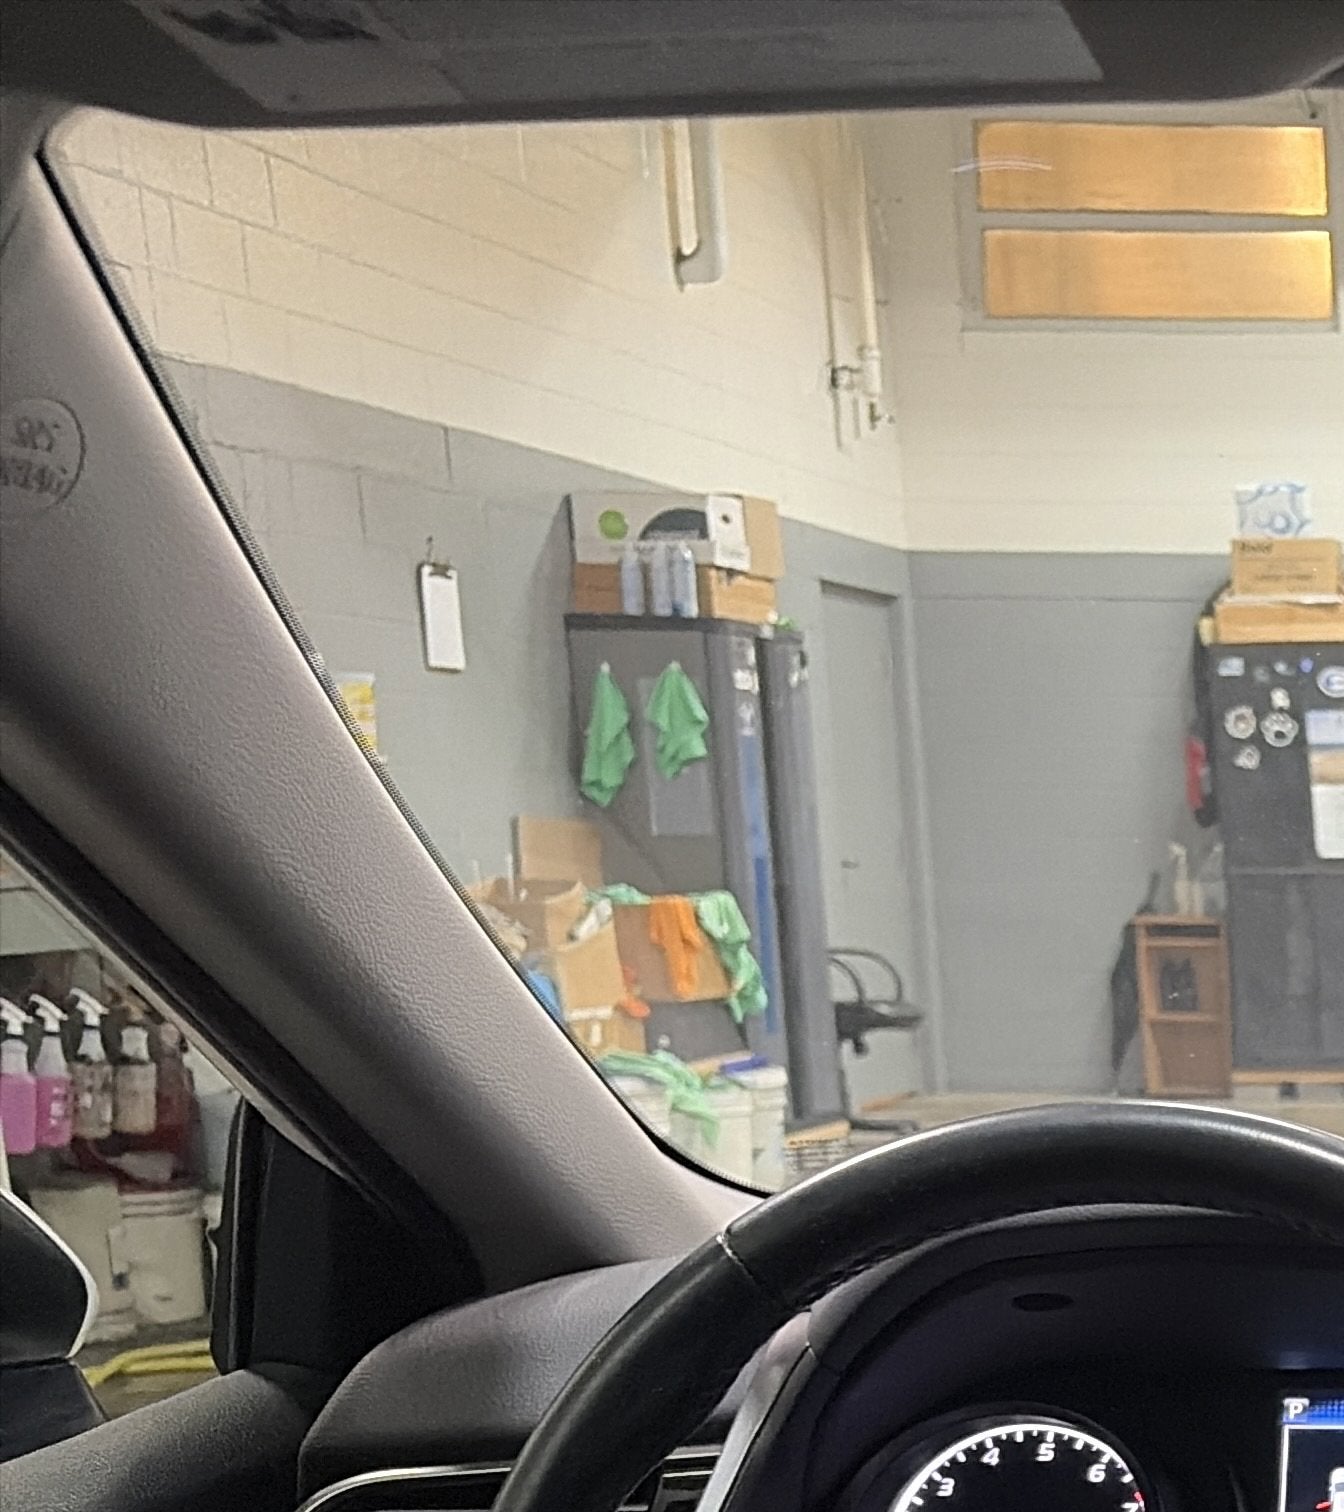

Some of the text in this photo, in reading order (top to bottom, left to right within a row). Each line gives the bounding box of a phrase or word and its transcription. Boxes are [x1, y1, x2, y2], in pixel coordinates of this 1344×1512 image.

[1289, 1403, 1303, 1420] P
[980, 1447, 1000, 1466] 4
[1036, 1442, 1056, 1462] 5
[1087, 1464, 1106, 1483] 6
[936, 1477, 955, 1497] 3
